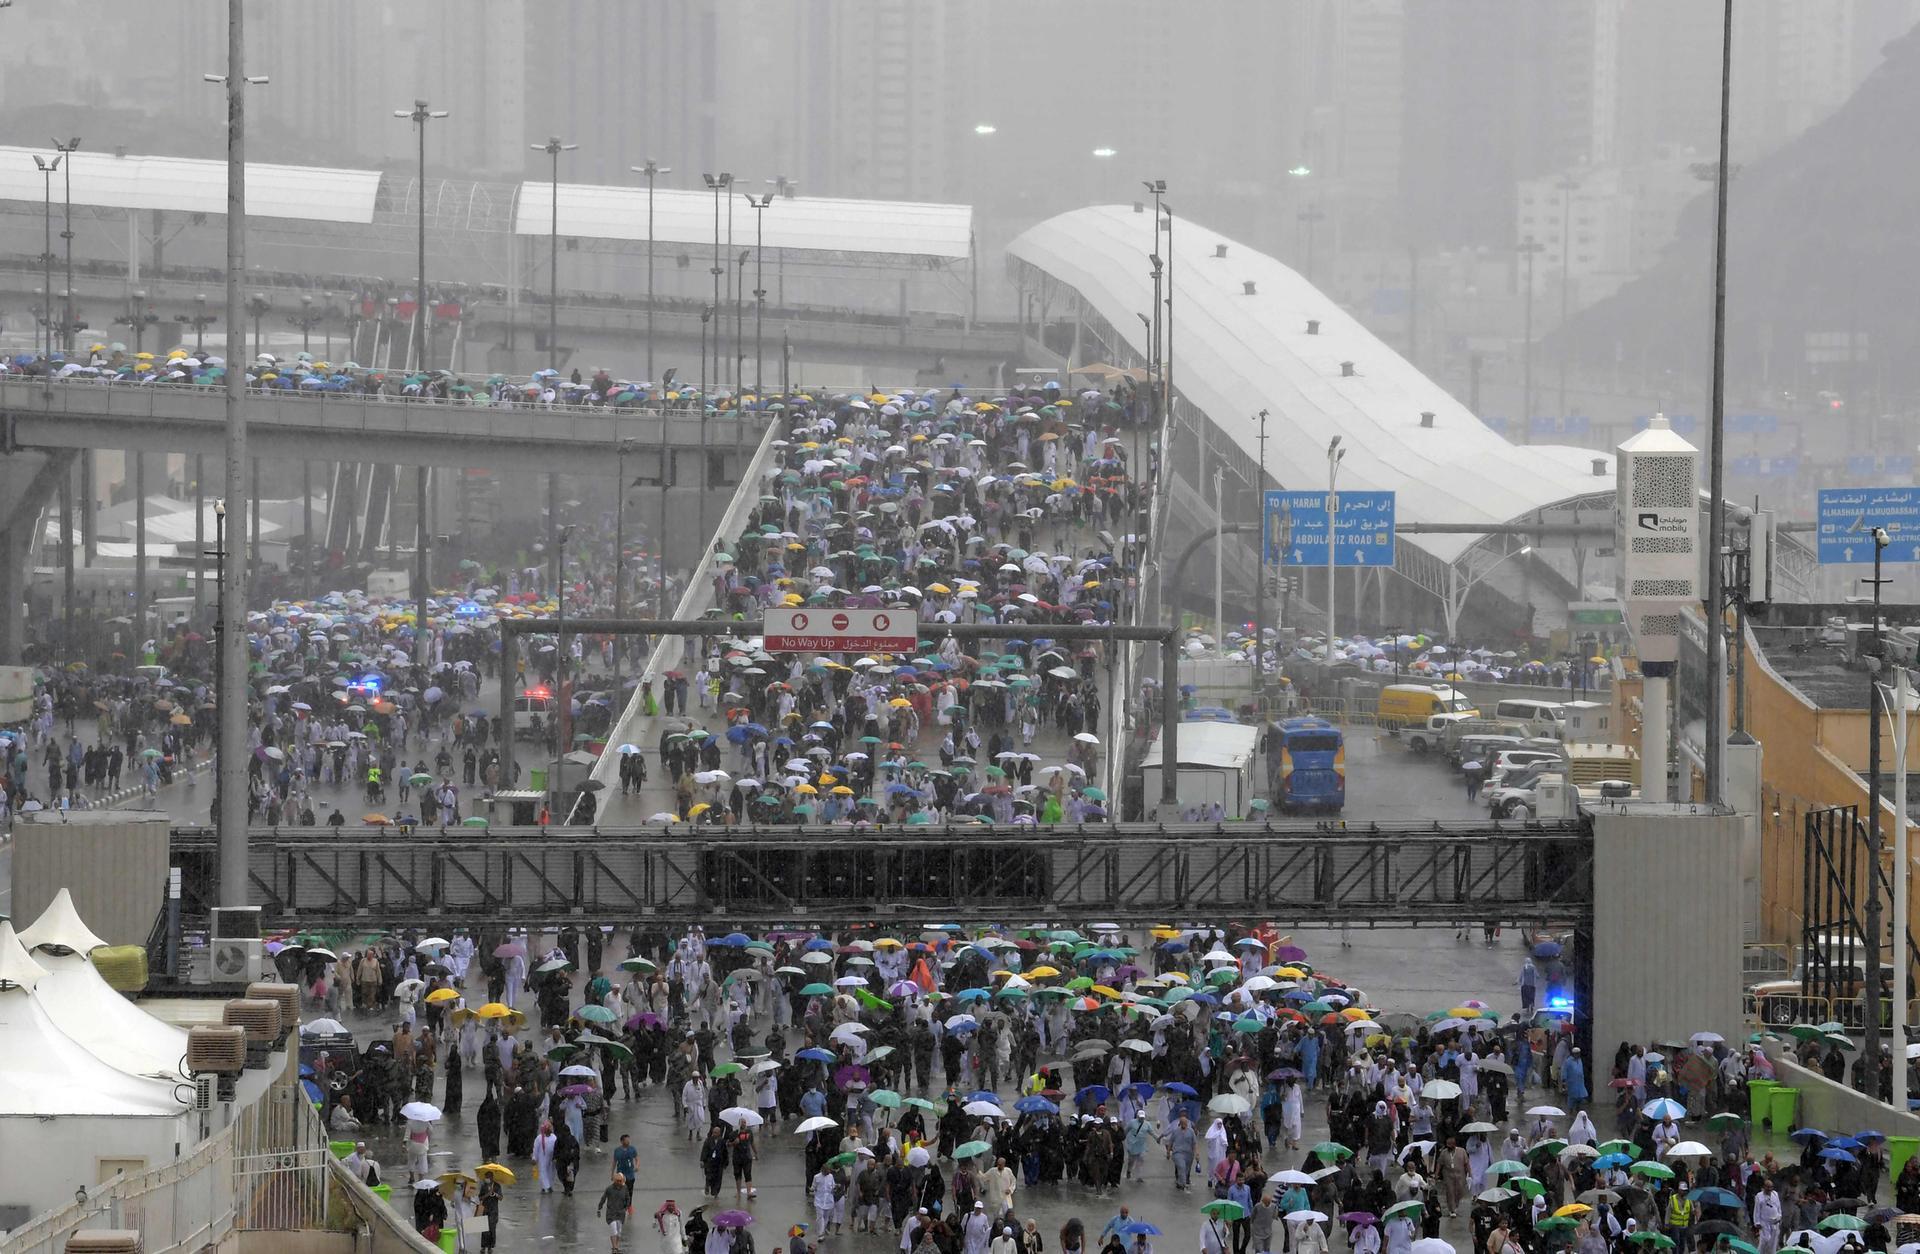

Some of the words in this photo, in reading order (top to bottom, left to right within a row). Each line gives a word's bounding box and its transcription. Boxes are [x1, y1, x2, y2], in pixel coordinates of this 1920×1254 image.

[1268, 497, 1280, 508] TO
[1293, 497, 1321, 508] HARAM
[1823, 493, 1867, 505] المقدسة
[1870, 492, 1912, 505] المشاعر
[1343, 499, 1374, 513] الحرم
[1376, 499, 1391, 512] إلى
[1360, 518, 1389, 531] طريق
[1659, 524, 1687, 533] mobily
[1348, 534, 1372, 545] ROAD
[781, 637, 796, 648] No
[797, 637, 818, 650] Way
[820, 637, 835, 650] Up
[842, 639, 872, 650] الدخول
